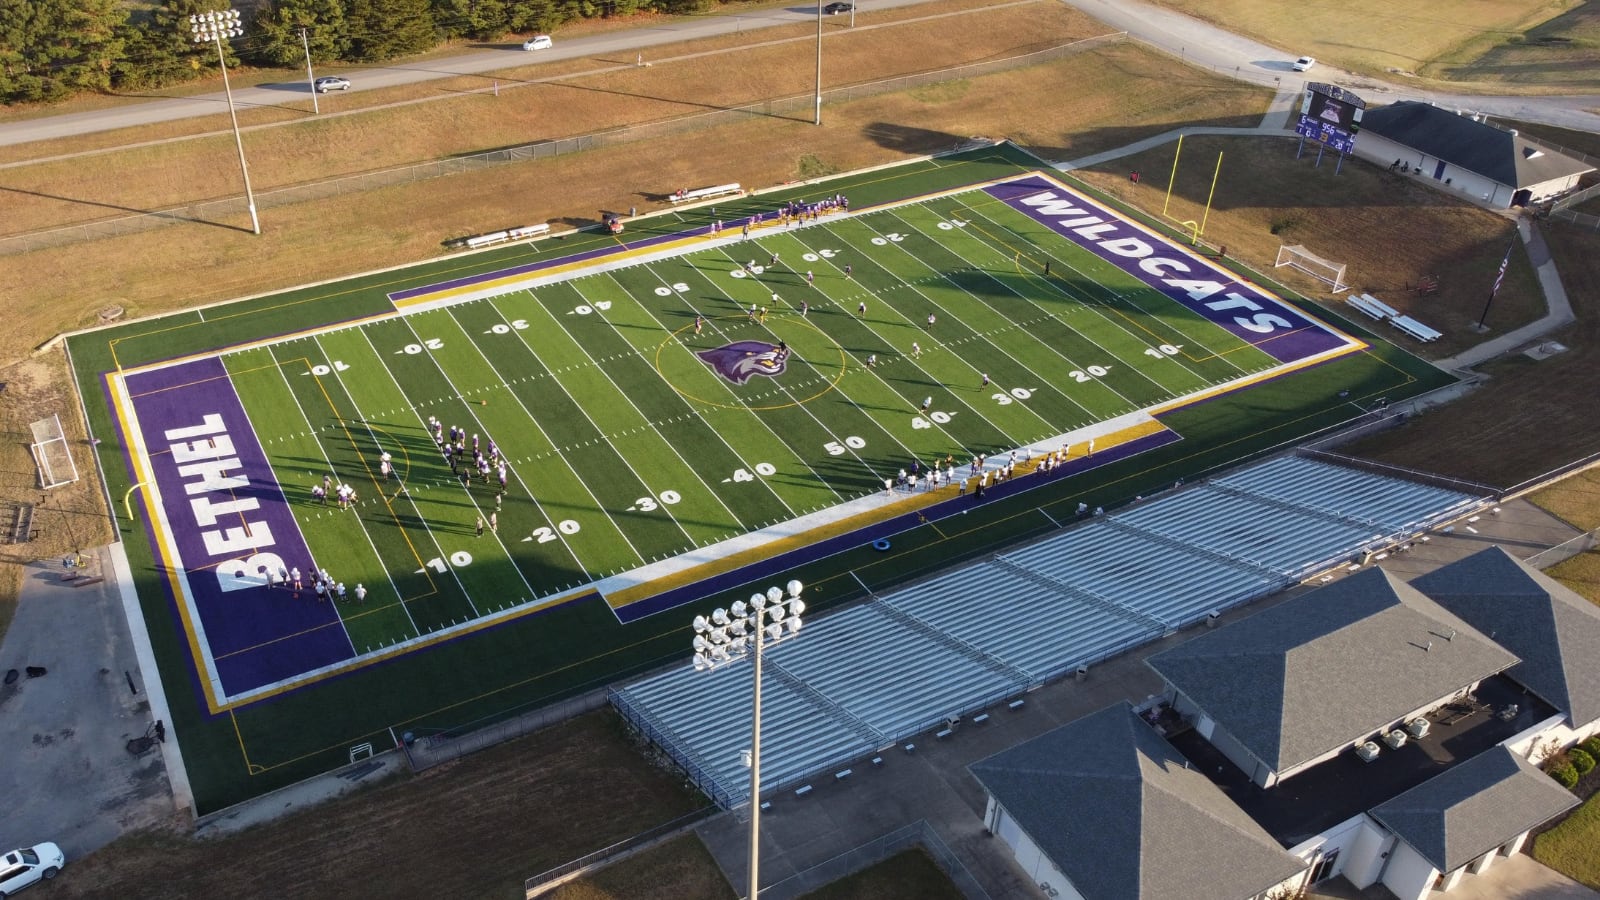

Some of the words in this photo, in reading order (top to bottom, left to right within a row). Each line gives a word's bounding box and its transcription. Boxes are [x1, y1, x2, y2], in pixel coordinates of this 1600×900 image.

[937, 219, 967, 230] 10
[871, 233, 904, 245] 20
[803, 249, 836, 261] 30
[1020, 191, 1293, 333] WILDCATS
[655, 283, 690, 297] 50
[576, 301, 612, 315] 40
[492, 319, 530, 334] 30
[404, 338, 444, 355] 20
[1145, 344, 1179, 359] 10
[312, 361, 350, 376] 10
[1069, 365, 1108, 382] 20
[992, 387, 1032, 405] 30
[911, 411, 952, 430] 40
[823, 436, 866, 456] 50
[733, 462, 777, 483] 40
[164, 413, 291, 593] BETHEL
[635, 490, 681, 512] 30
[532, 520, 580, 544] 20
[427, 551, 472, 574] 10
